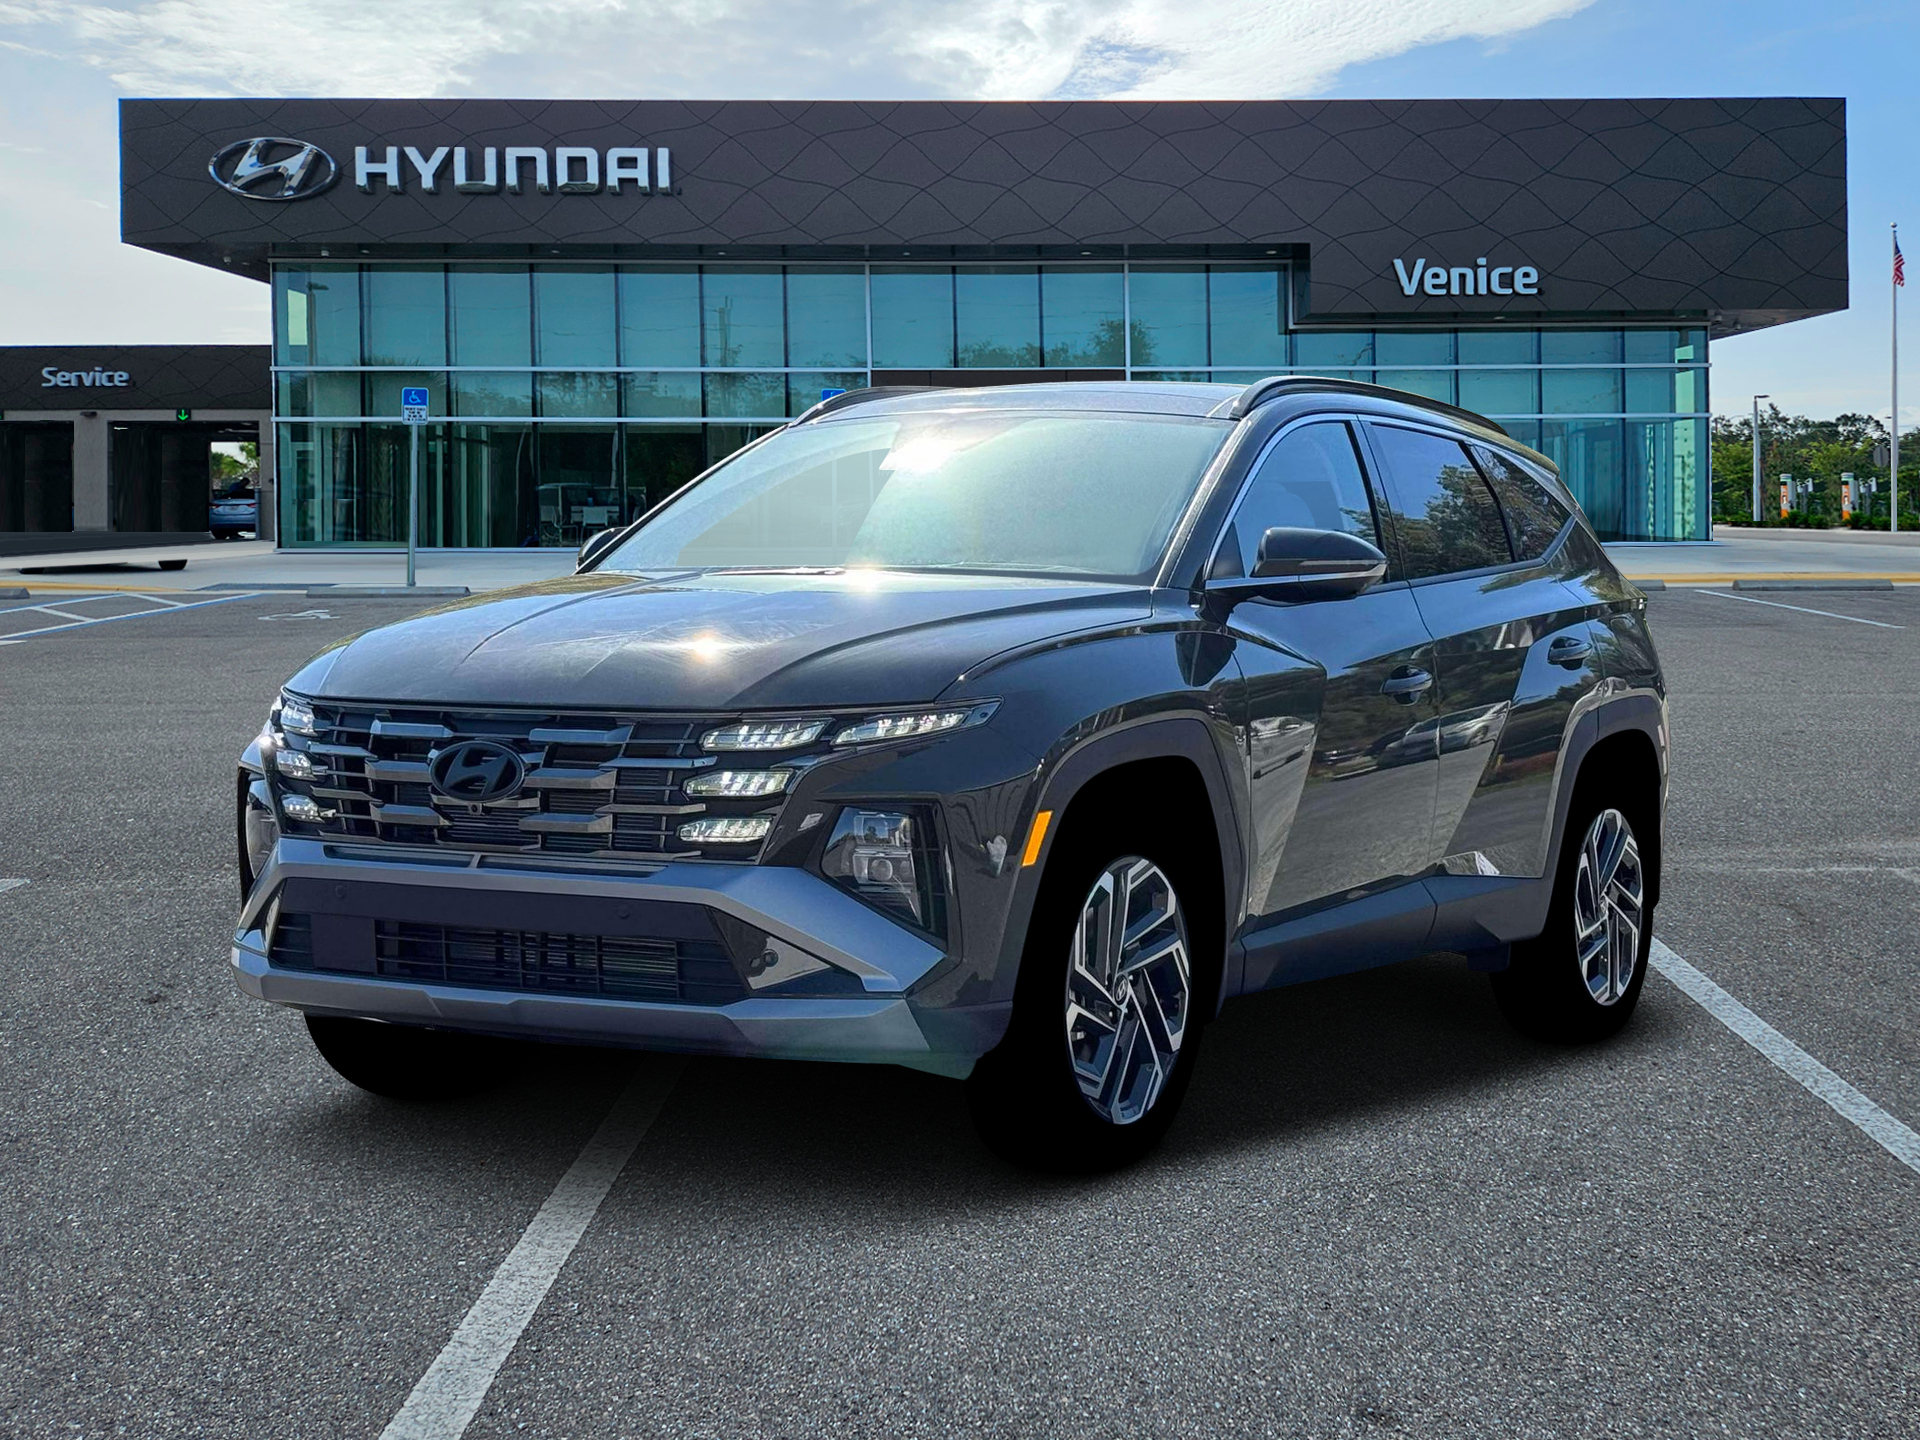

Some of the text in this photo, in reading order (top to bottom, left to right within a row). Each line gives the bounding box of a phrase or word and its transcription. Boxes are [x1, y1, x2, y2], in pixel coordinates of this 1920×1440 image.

[354, 146, 671, 194] HYUNDAI
[1393, 257, 1539, 296] Venice
[41, 366, 130, 387] Service
